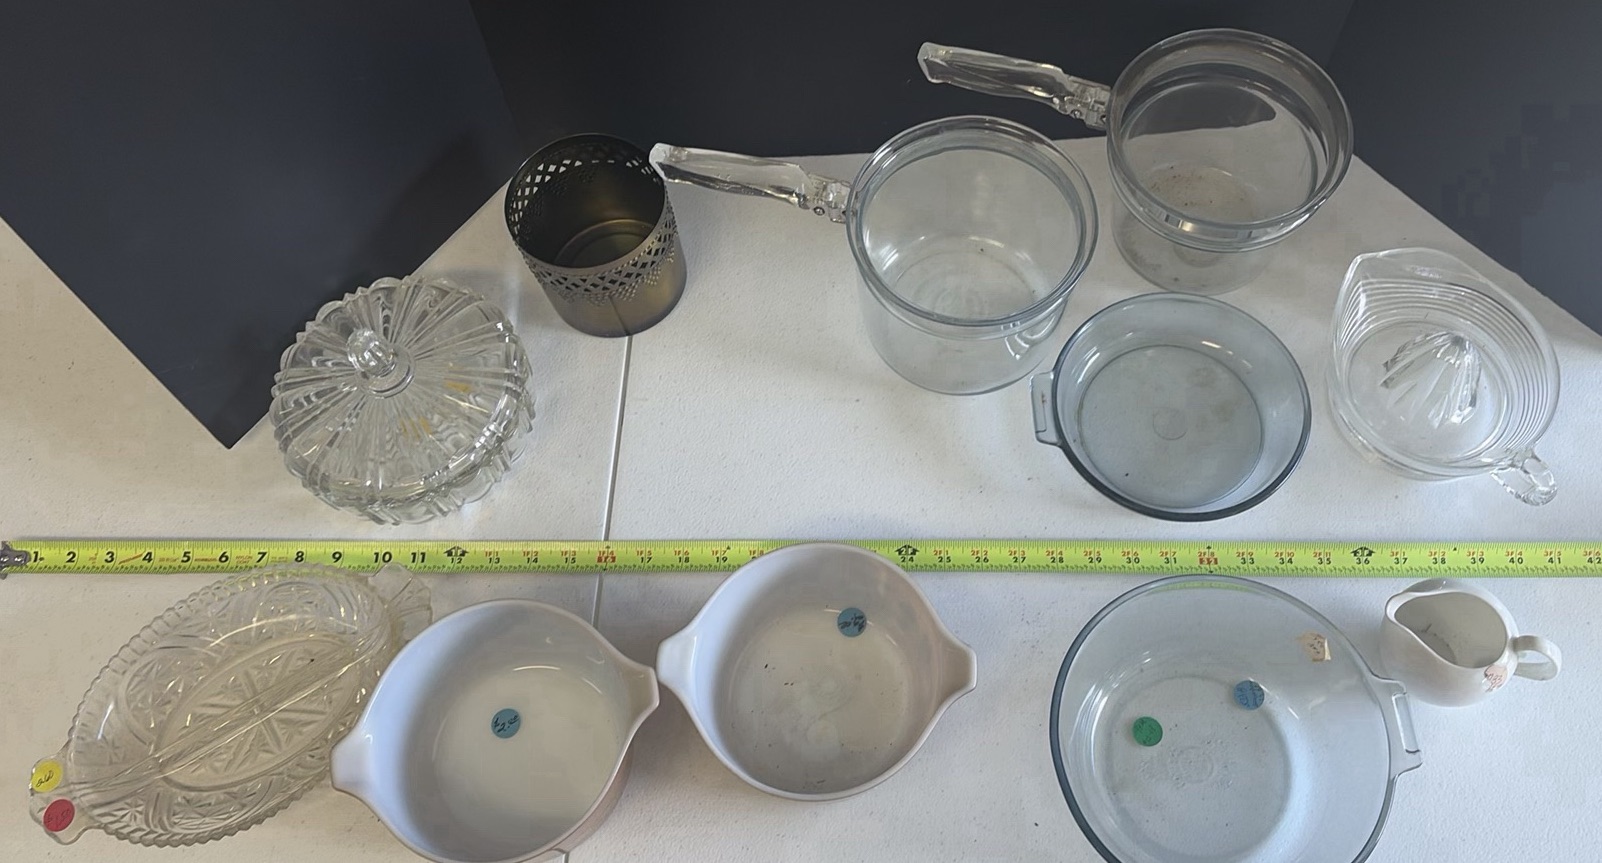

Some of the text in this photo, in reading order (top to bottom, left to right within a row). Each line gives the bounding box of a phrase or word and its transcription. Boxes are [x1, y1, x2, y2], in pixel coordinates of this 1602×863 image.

[32, 551, 39, 562] 1
[66, 551, 77, 563] 2
[104, 551, 115, 563] 3
[142, 551, 153, 563] 4
[181, 551, 191, 563] 5
[219, 551, 229, 563] 6
[256, 551, 267, 563] 7
[295, 551, 305, 563] 8
[332, 551, 342, 563] 9
[373, 552, 393, 563] 10
[411, 552, 426, 563] 11
[1279, 557, 1293, 565] 34
[1318, 557, 1331, 565] 35
[1356, 557, 1370, 565] 36
[1394, 557, 1408, 565] 37
